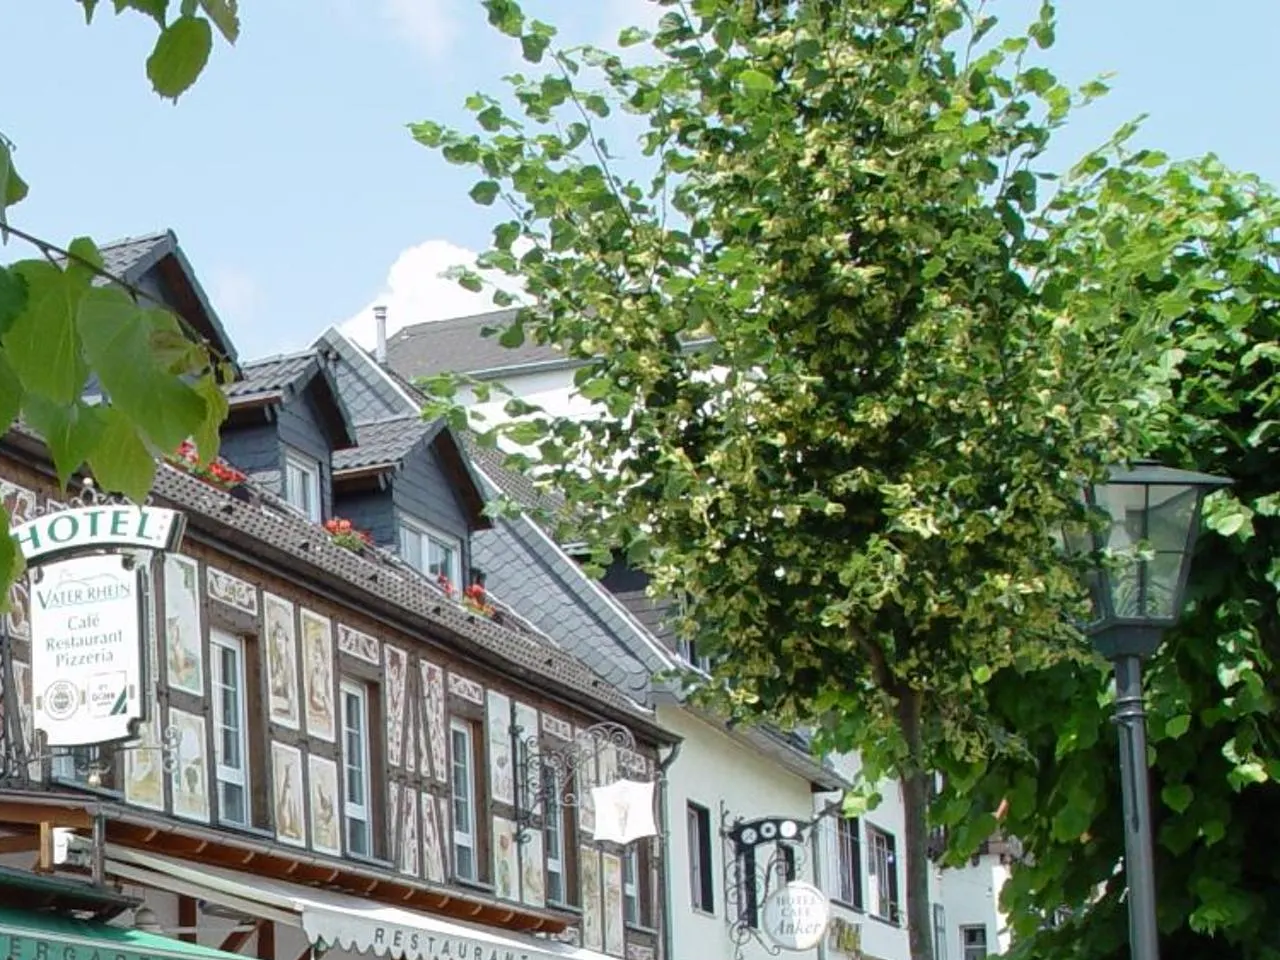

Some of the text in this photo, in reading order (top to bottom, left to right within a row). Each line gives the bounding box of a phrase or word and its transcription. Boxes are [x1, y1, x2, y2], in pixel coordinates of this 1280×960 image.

[14, 510, 153, 549] HOTEL
[36, 583, 131, 610] VATER RHEIN
[68, 612, 100, 630] Café
[46, 629, 122, 652] Restaurant
[56, 651, 114, 667] Pizzeria
[774, 919, 821, 935] Anker
